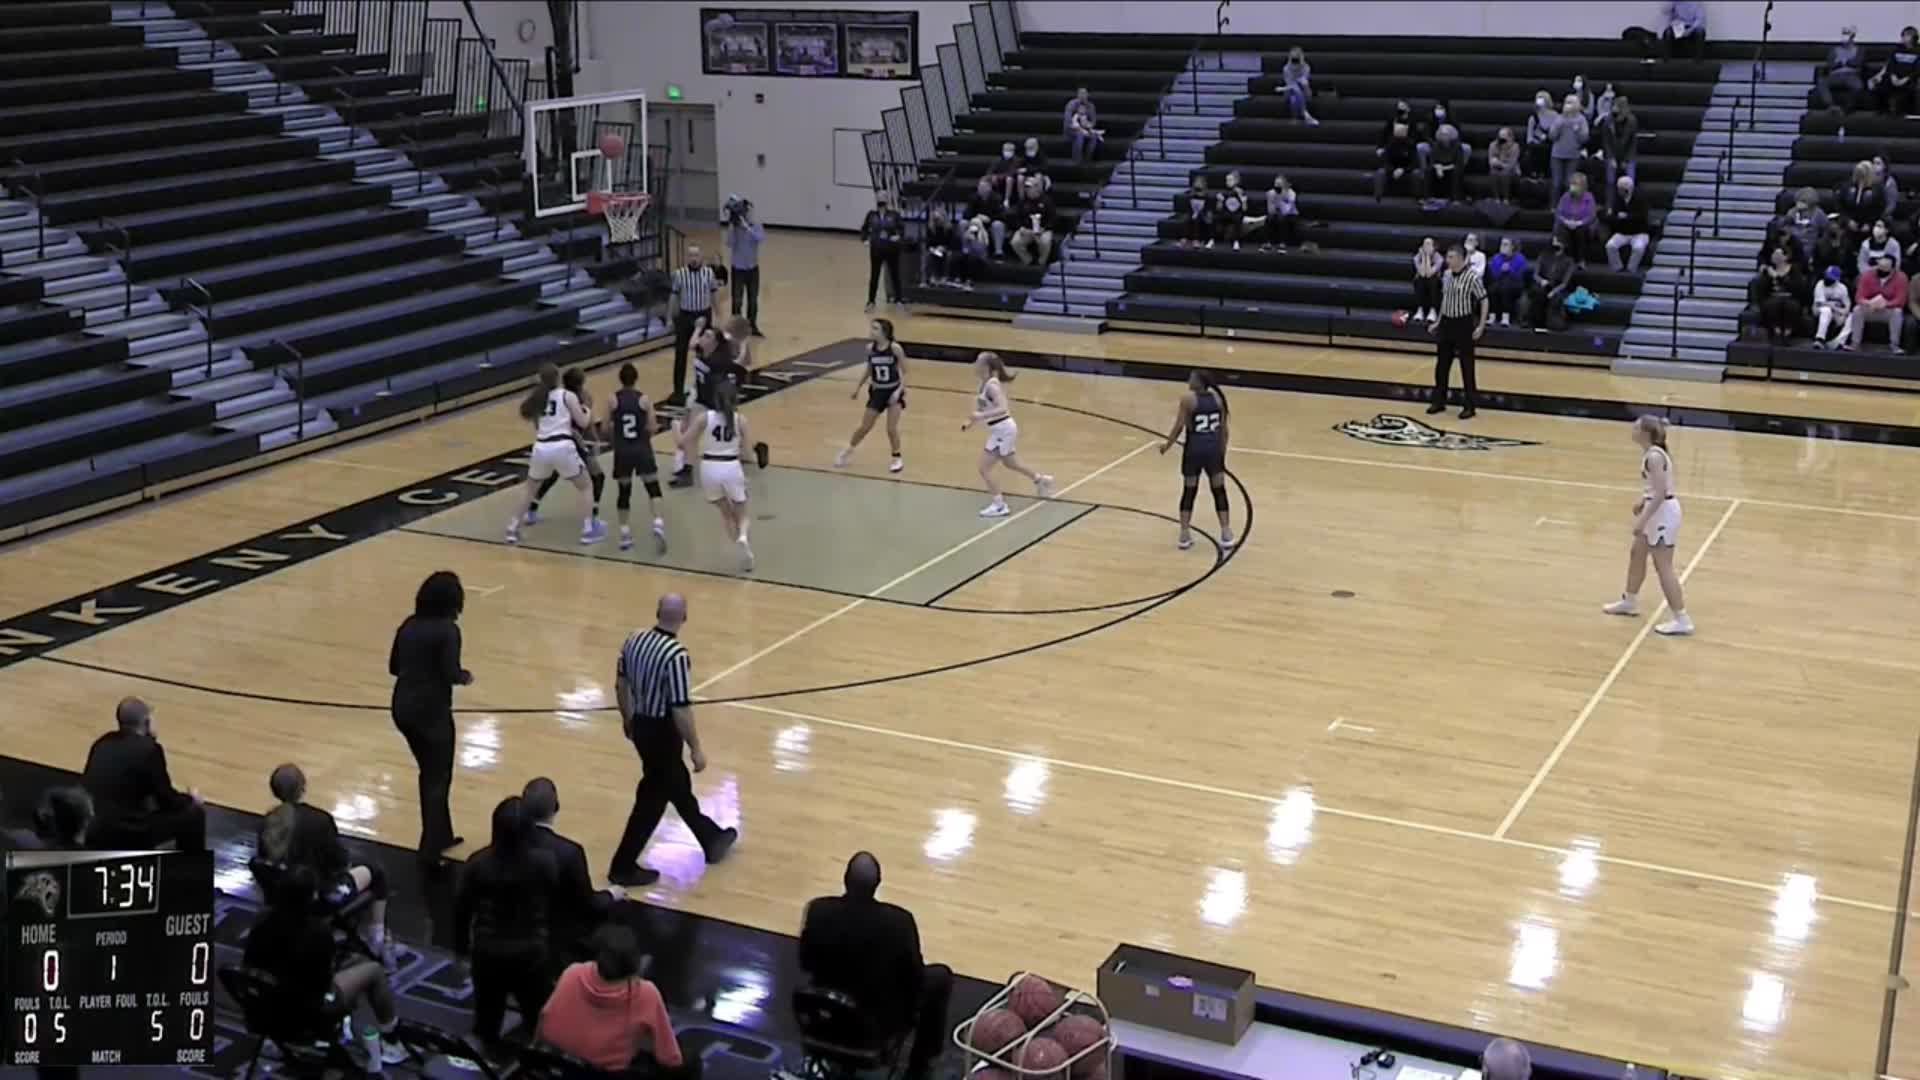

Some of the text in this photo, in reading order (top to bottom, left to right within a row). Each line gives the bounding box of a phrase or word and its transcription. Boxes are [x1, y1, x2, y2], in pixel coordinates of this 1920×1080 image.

[621, 414, 639, 439] 2
[1195, 412, 1220, 433] 22
[711, 425, 735, 443] 40
